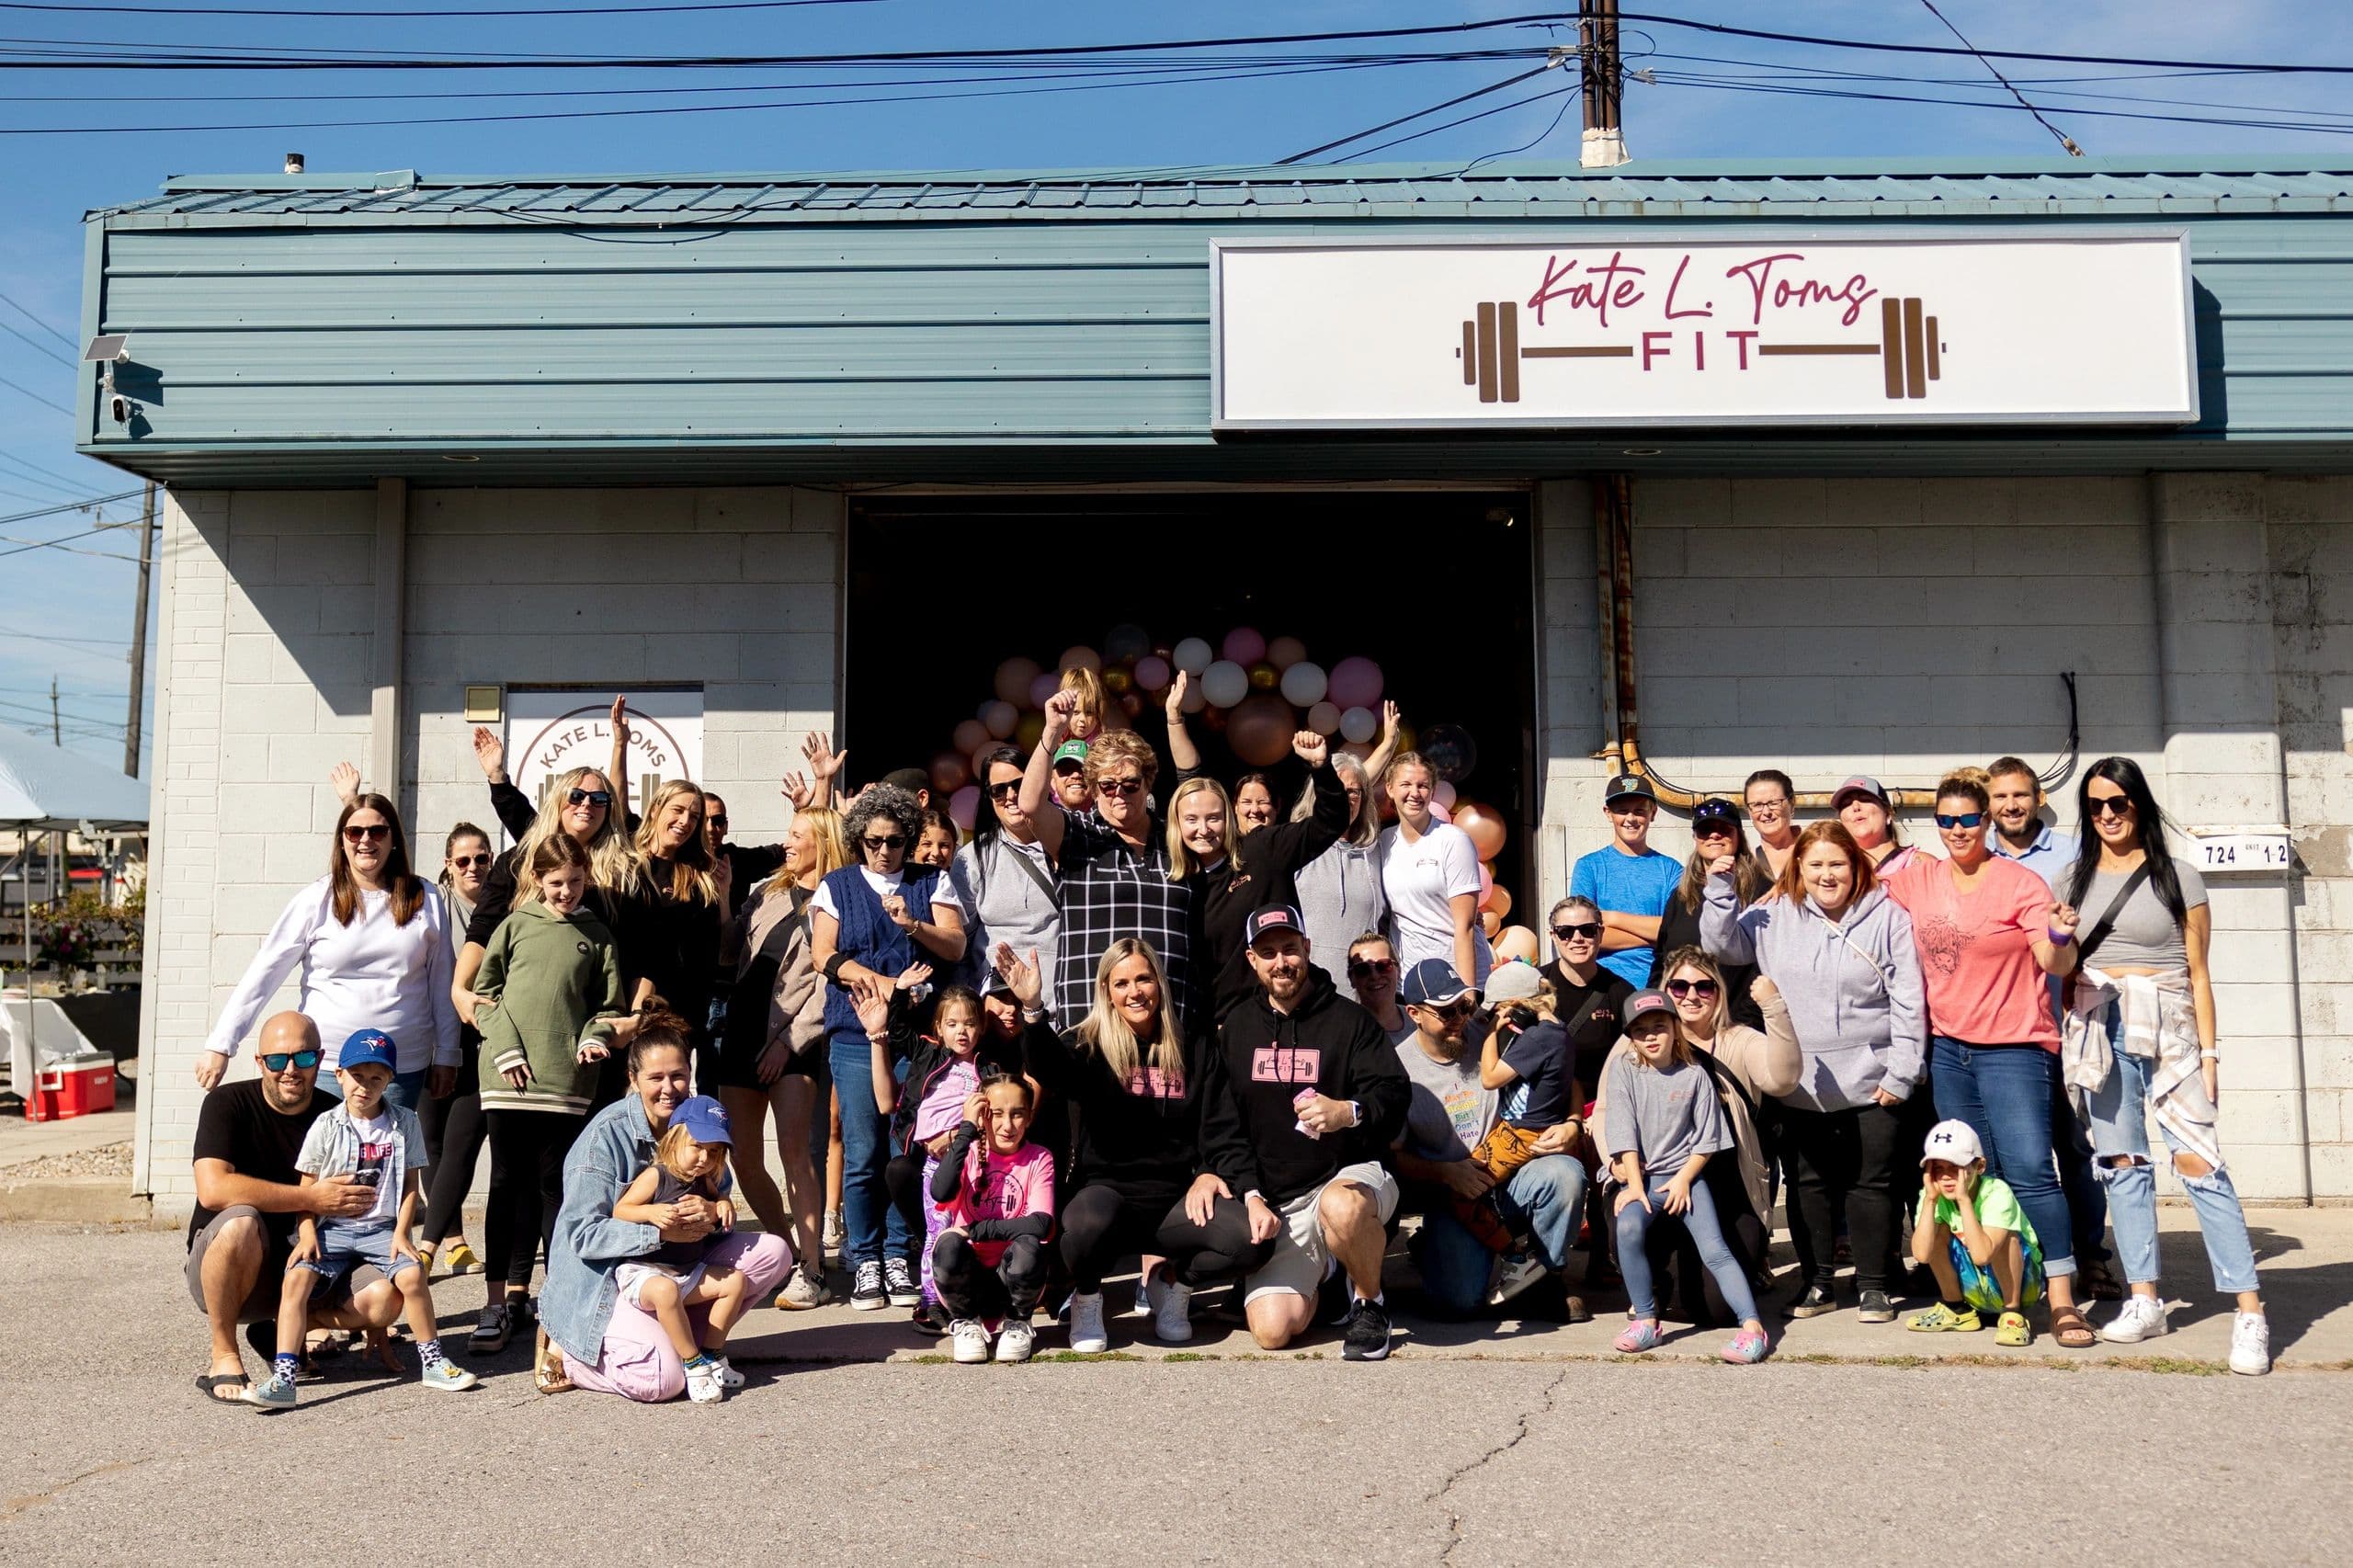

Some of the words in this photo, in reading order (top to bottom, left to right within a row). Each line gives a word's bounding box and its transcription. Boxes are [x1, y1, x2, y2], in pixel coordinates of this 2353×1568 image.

[1527, 251, 1646, 328] Kate
[1665, 255, 1713, 320] L.
[1726, 254, 1878, 326] Toms
[1642, 331, 1759, 371] FIT
[540, 726, 588, 769] KATE
[594, 722, 609, 737] L.
[629, 730, 666, 767] OMS
[2205, 846, 2235, 864] 724
[1460, 1131, 1479, 1140] Hate
[370, 1143, 391, 1158] LIFE
